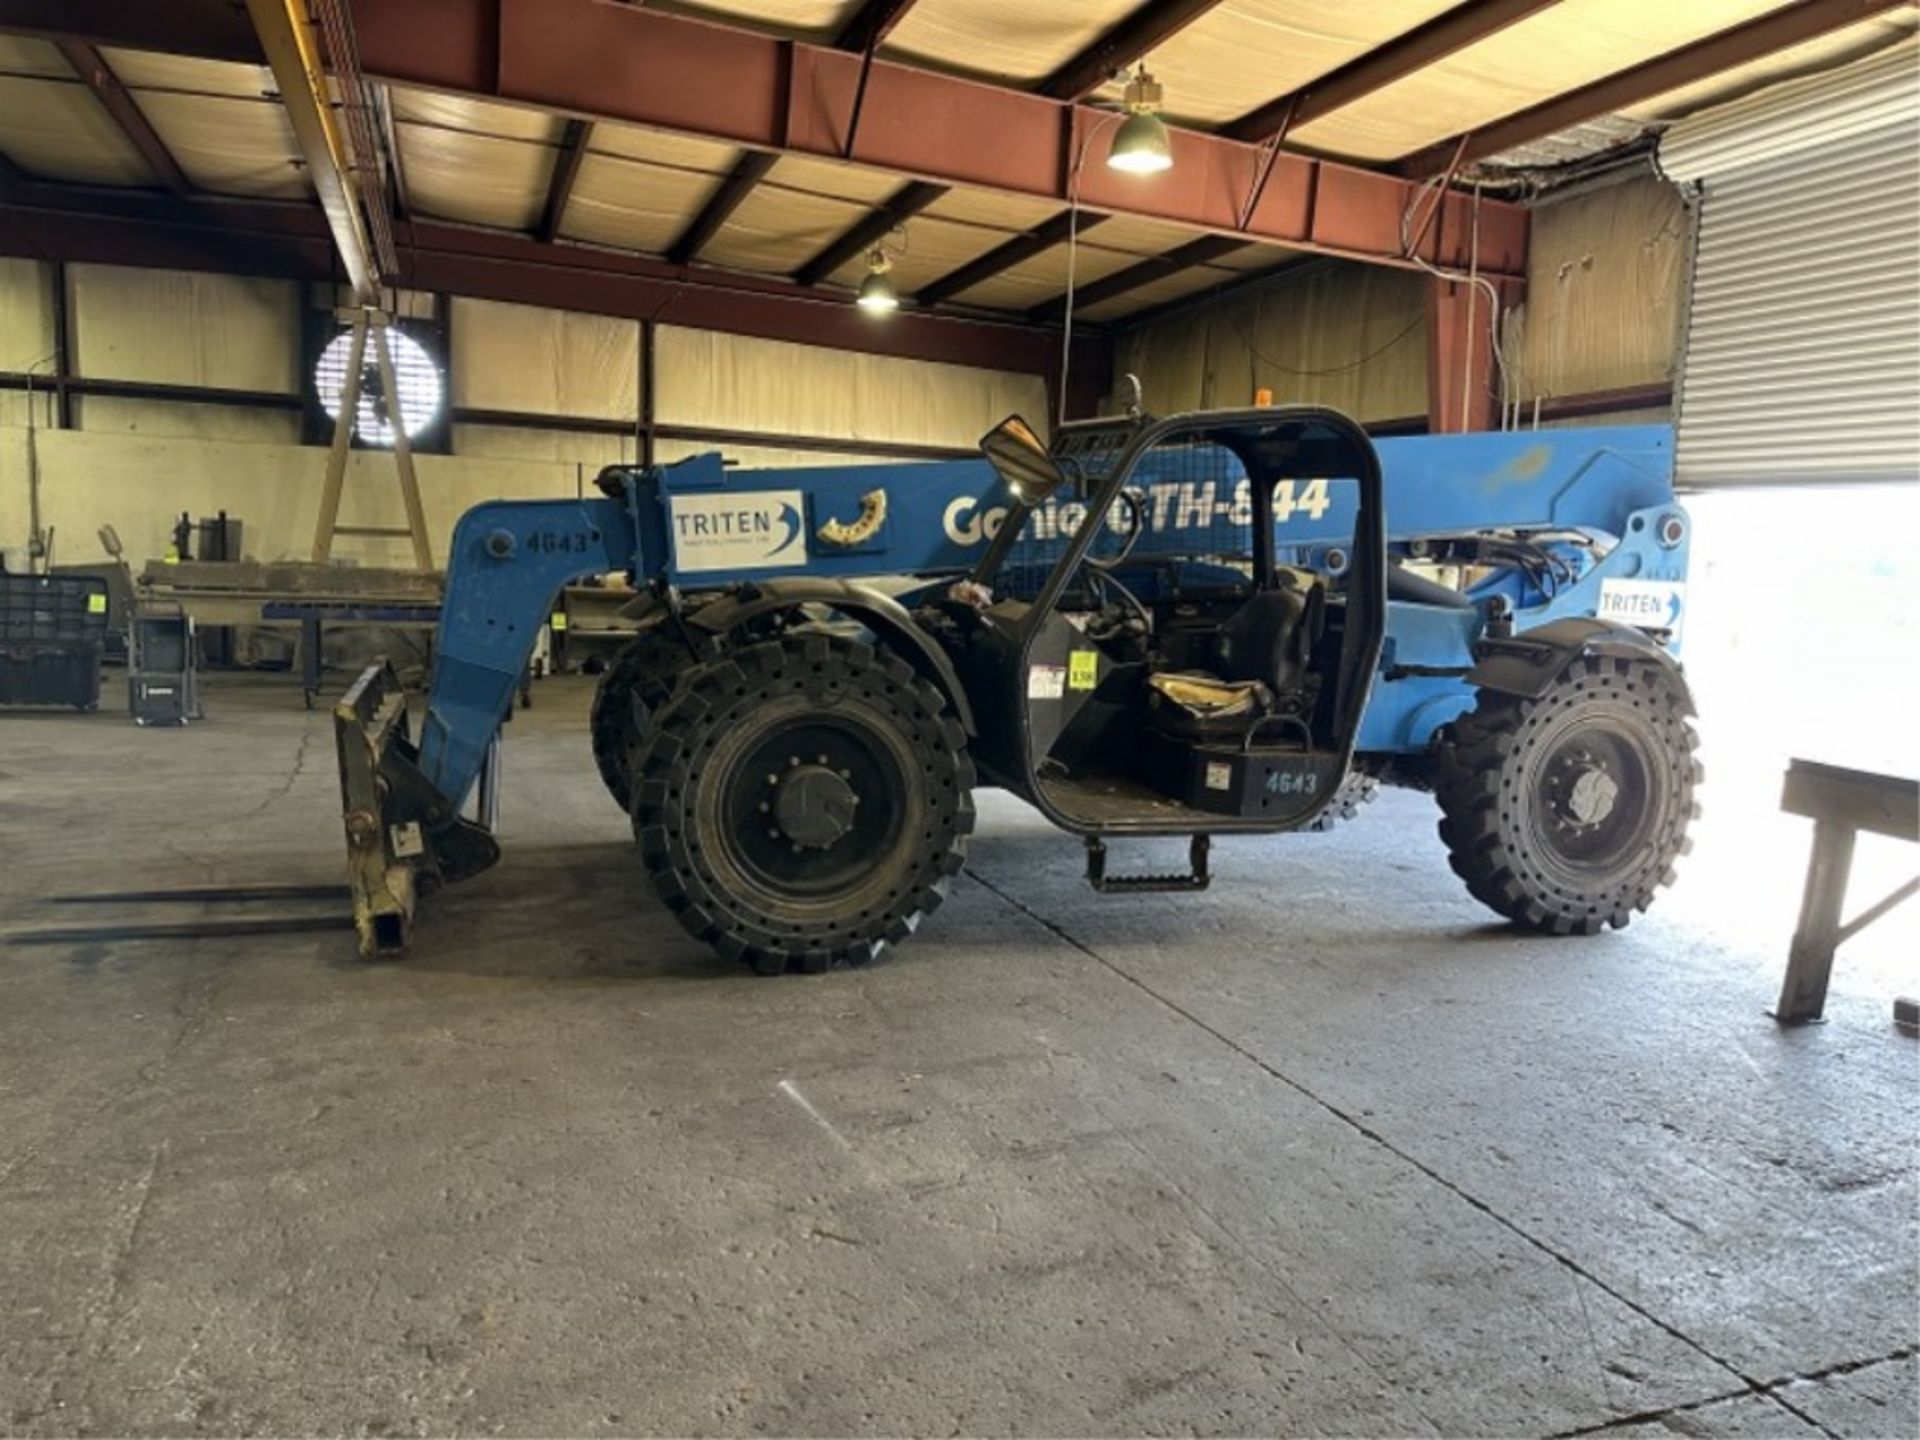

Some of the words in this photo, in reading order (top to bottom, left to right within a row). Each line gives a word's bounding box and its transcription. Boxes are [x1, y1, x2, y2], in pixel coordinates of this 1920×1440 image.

[676, 510, 770, 536] TRITEN
[527, 531, 586, 553] 4643
[1603, 592, 1661, 612] TRITEN
[1267, 771, 1316, 794] 4643
